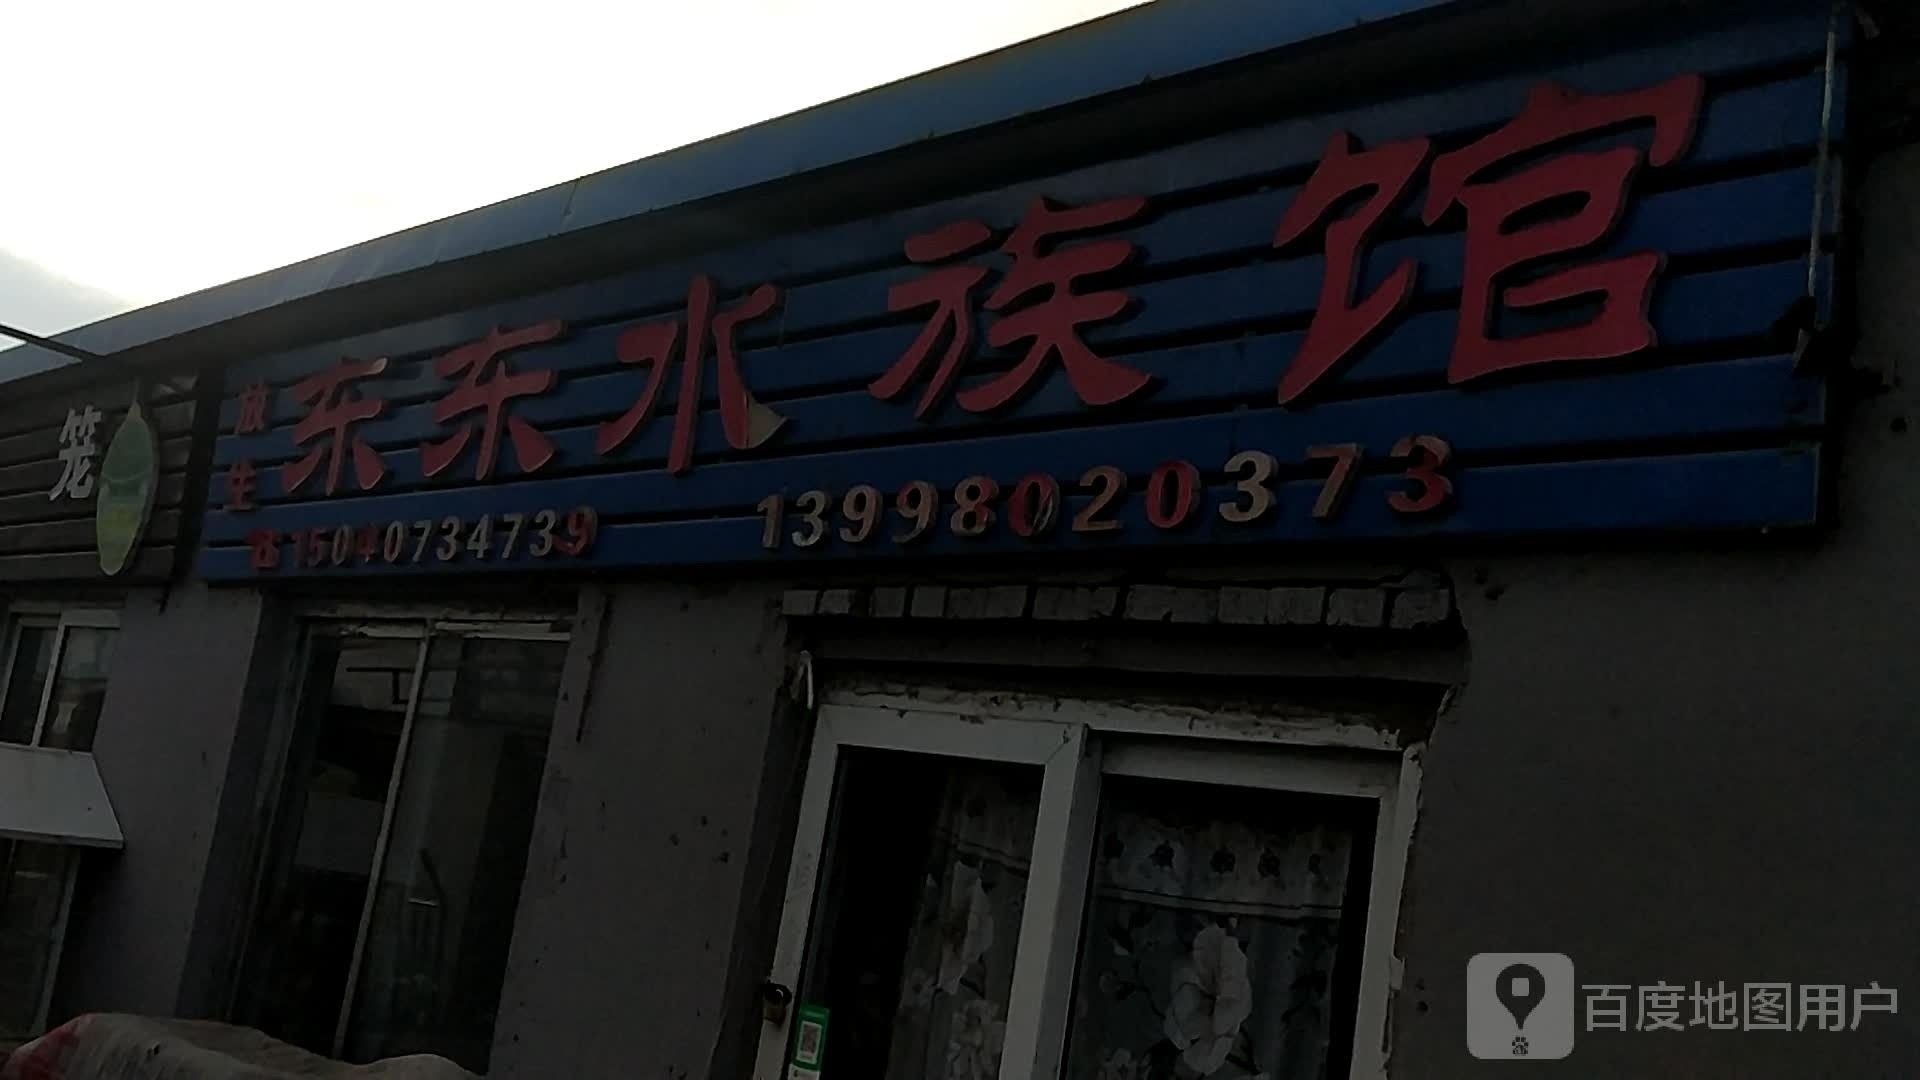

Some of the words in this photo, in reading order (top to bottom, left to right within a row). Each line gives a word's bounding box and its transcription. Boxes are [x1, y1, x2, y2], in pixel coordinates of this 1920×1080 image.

[282, 73, 1704, 497] 东东水族馆
[49, 403, 102, 503] 笼
[755, 434, 1455, 550] 13998020373
[292, 505, 598, 568] 15040734739
